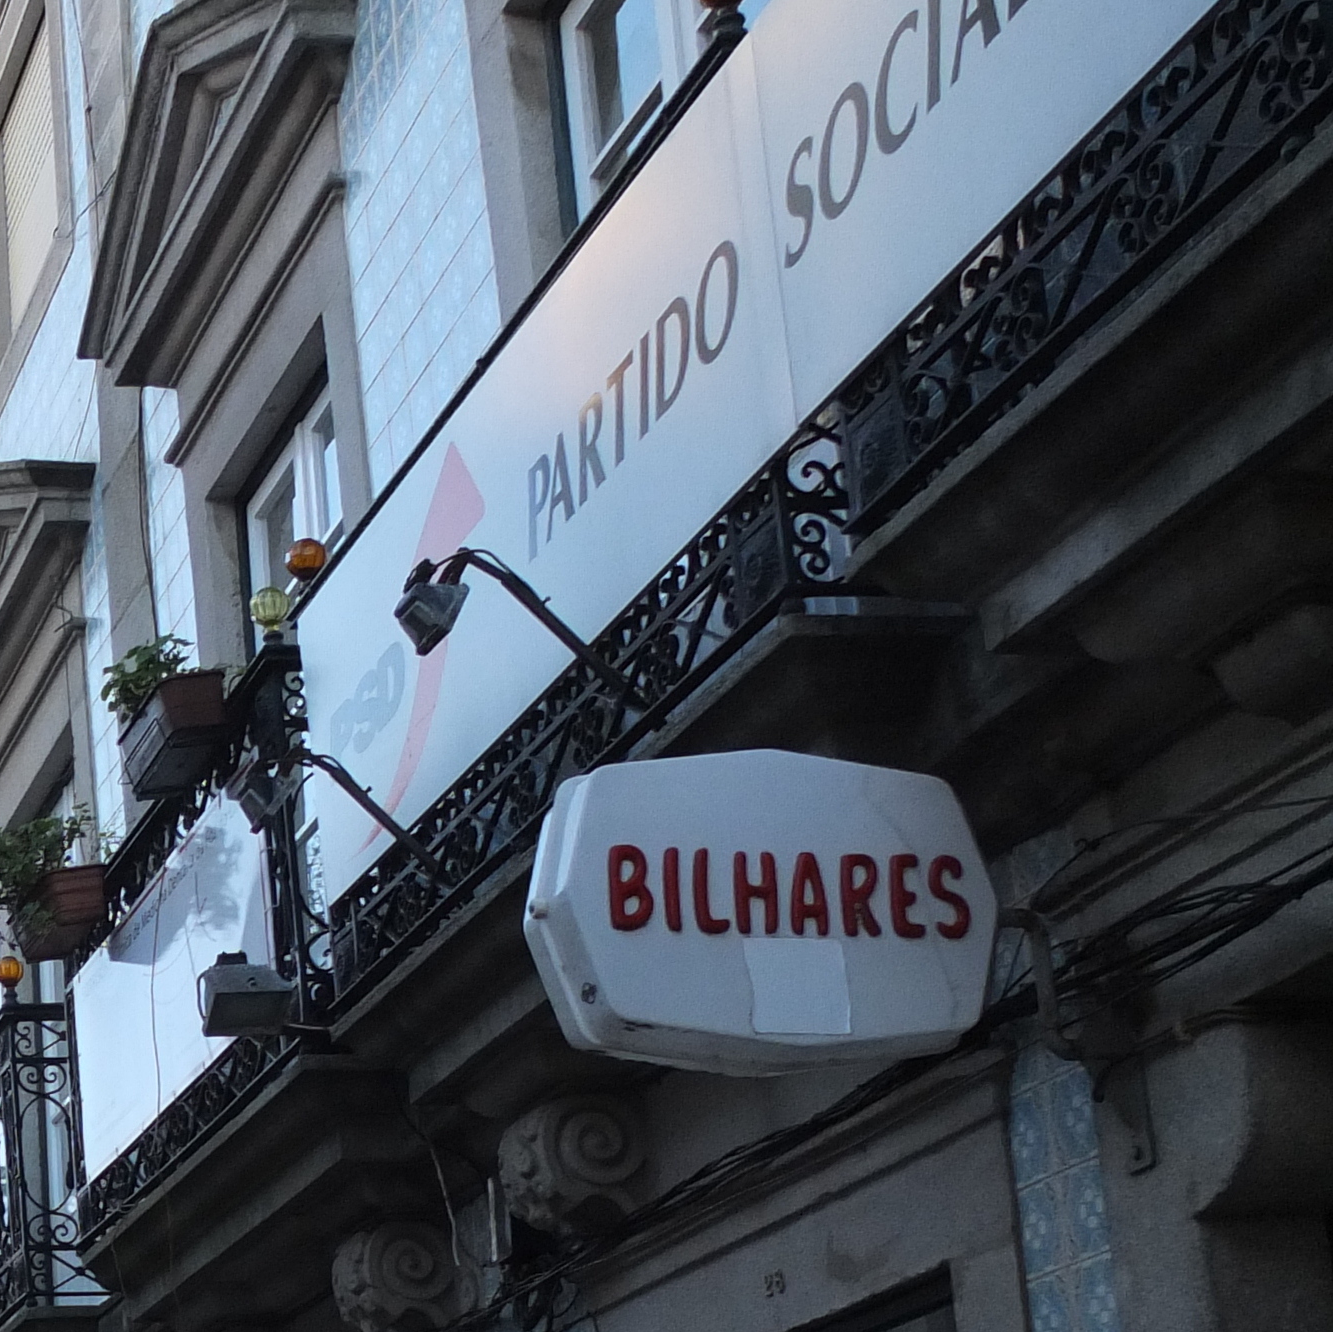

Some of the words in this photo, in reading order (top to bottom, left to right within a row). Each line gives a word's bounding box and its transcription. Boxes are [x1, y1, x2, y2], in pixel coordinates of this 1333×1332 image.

[527, 240, 739, 564] PARTIDO
[785, 0, 1029, 269] SOCIA
[330, 641, 405, 757] PSD
[606, 844, 972, 940] BILHARES
